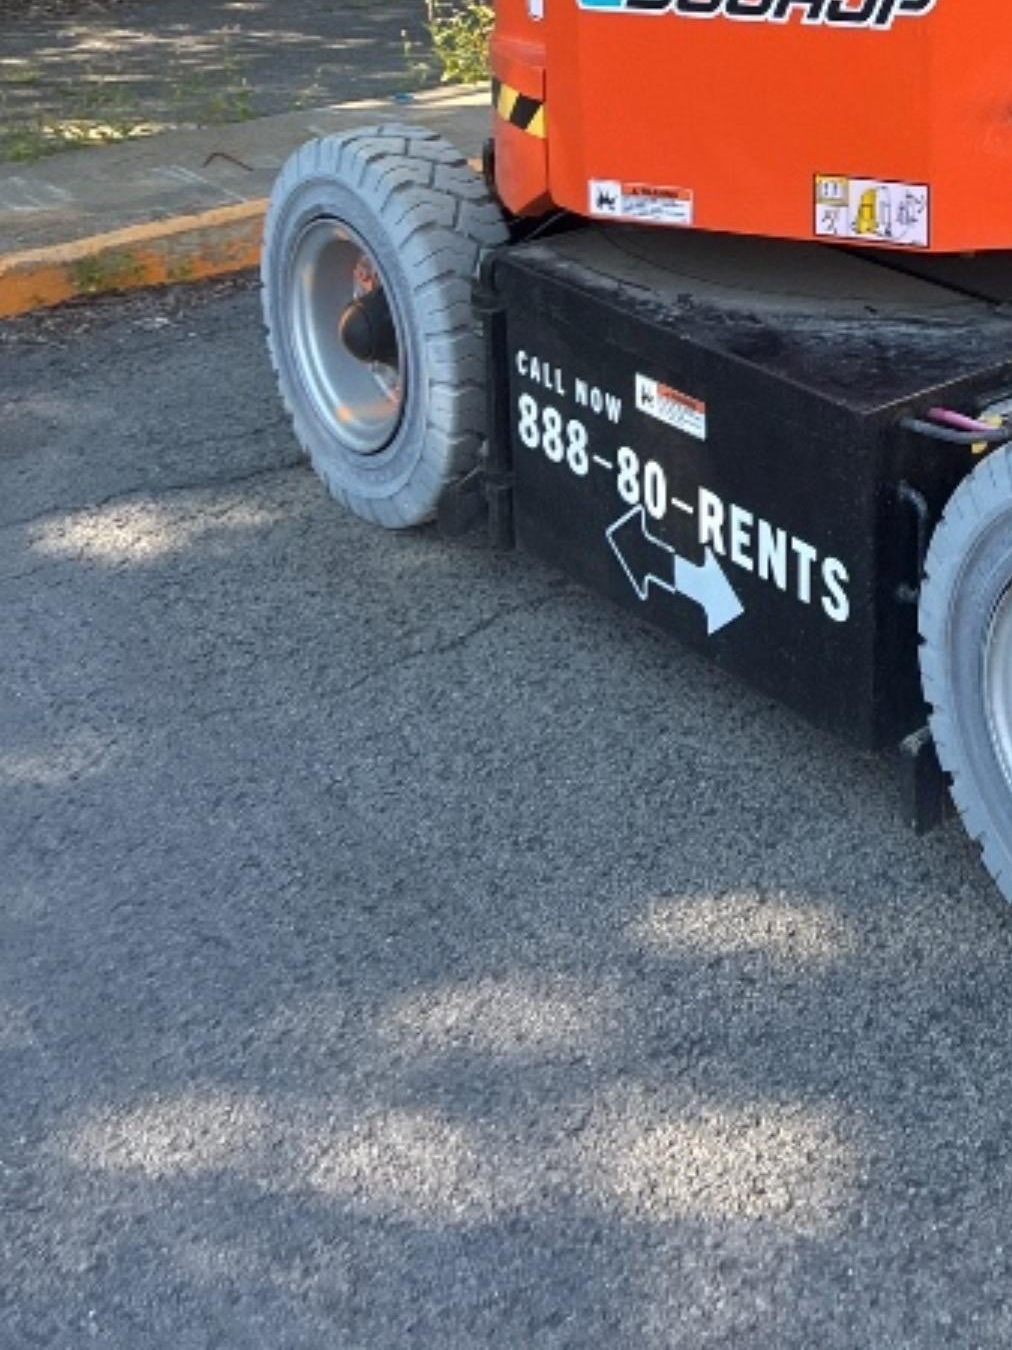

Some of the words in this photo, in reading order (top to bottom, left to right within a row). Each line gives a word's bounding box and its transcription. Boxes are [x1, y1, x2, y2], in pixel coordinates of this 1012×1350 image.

[516, 350, 565, 396] CALL
[575, 378, 622, 424] NOW
[517, 393, 850, 622] 888-80-RENTS
